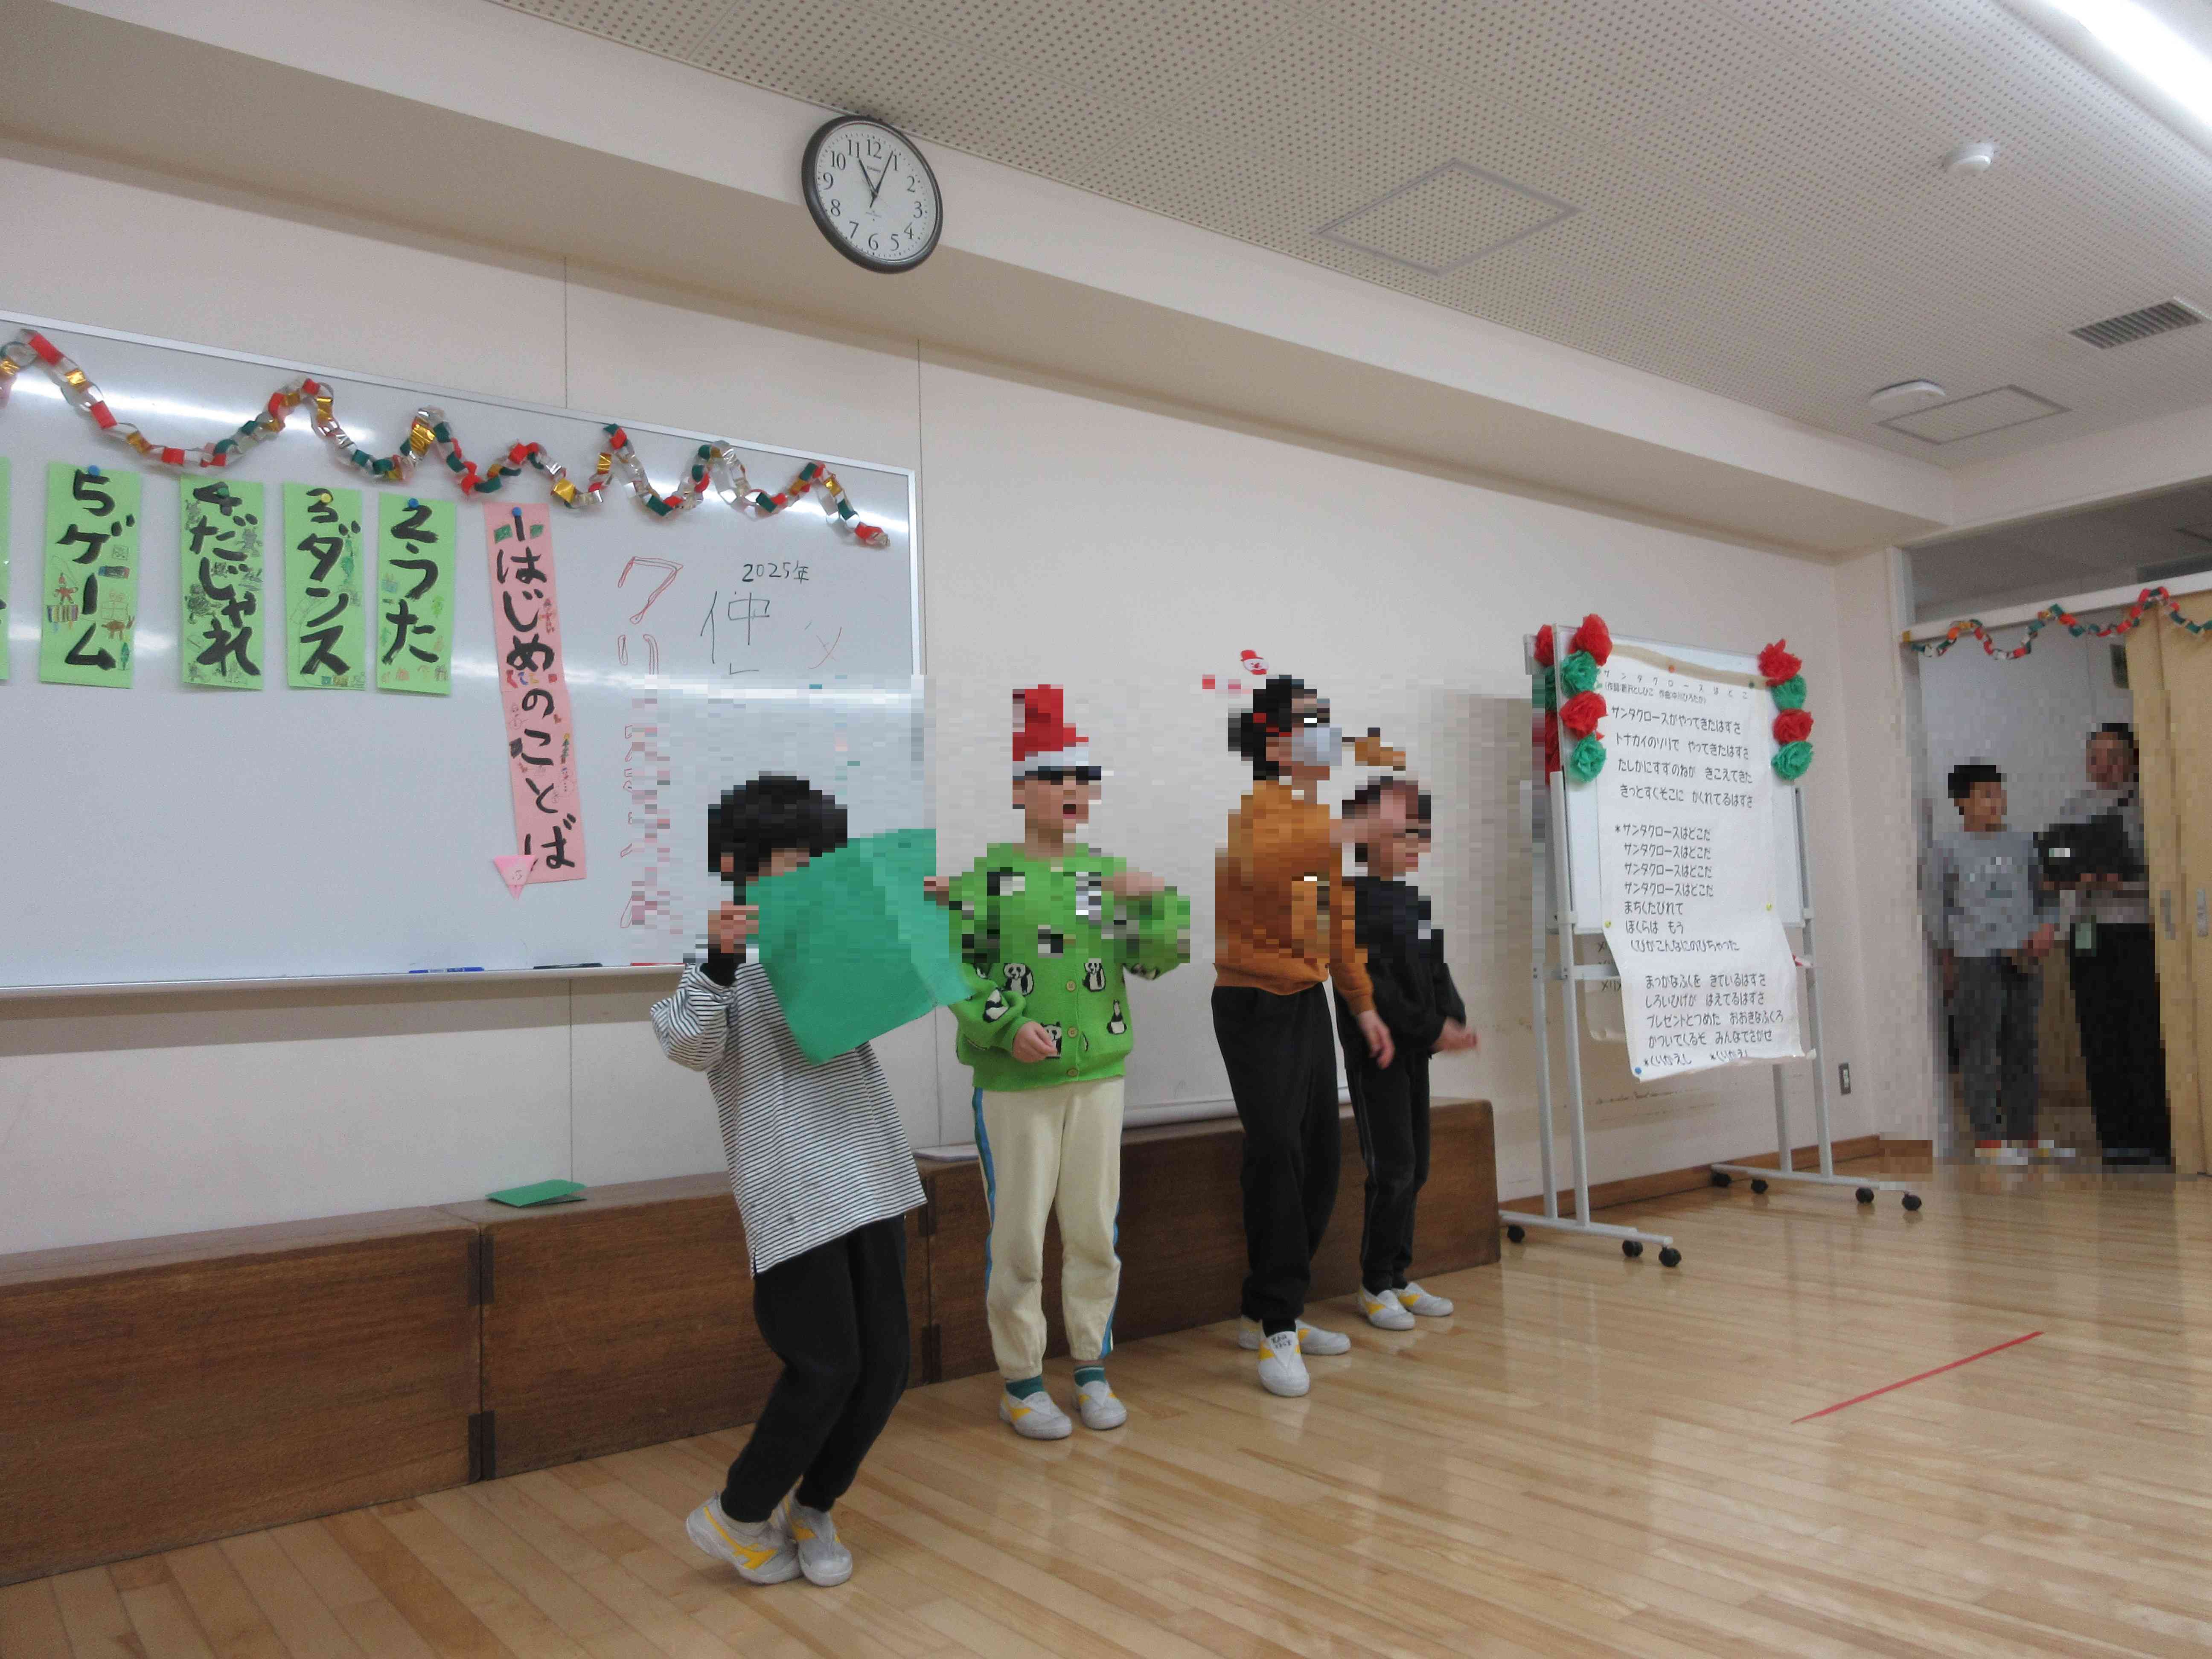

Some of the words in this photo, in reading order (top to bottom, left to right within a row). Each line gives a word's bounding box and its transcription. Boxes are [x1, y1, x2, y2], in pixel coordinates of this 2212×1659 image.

[848, 140, 859, 158] 11
[867, 140, 882, 159] 12
[831, 151, 846, 170] 10
[893, 154, 898, 171] 1
[823, 172, 833, 189] 9
[907, 175, 915, 192] 2
[831, 199, 840, 216] 8
[914, 201, 923, 218] 3
[849, 221, 859, 239] 7
[904, 223, 914, 239] 4
[868, 233, 879, 250] 6
[890, 234, 899, 250] 5
[742, 561, 809, 583] 2025年
[1705, 767, 1752, 783] きこえてきた
[1624, 843, 1711, 860] サンタクロースはどこだ
[1624, 862, 1712, 878] サンタクロースはどこだ
[1624, 882, 1713, 897] サンタクロースはどこだ
[1668, 921, 1683, 934] もう
